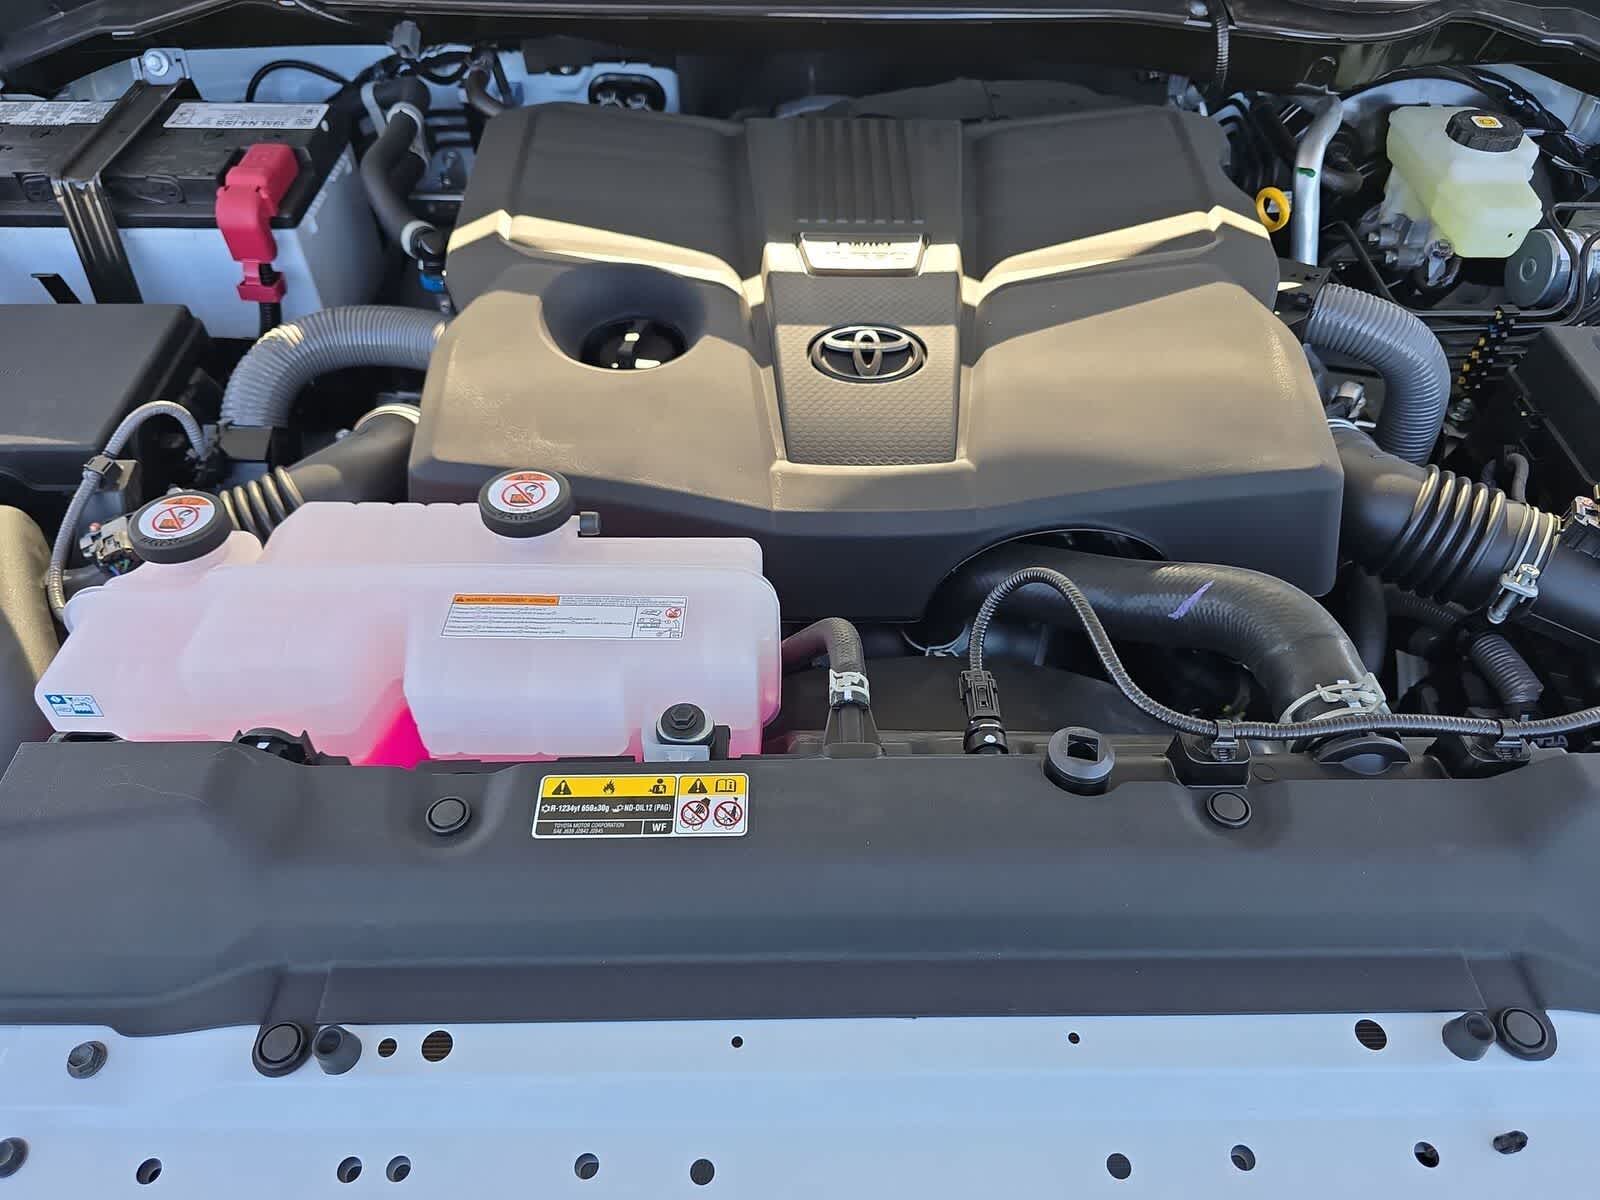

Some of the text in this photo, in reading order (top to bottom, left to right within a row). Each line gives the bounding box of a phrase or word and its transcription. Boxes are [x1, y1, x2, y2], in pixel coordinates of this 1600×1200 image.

[550, 804, 580, 813] R-1234yf
[581, 804, 610, 813] 650±30g
[653, 803, 671, 813] (PAG)
[652, 823, 668, 832] WF
